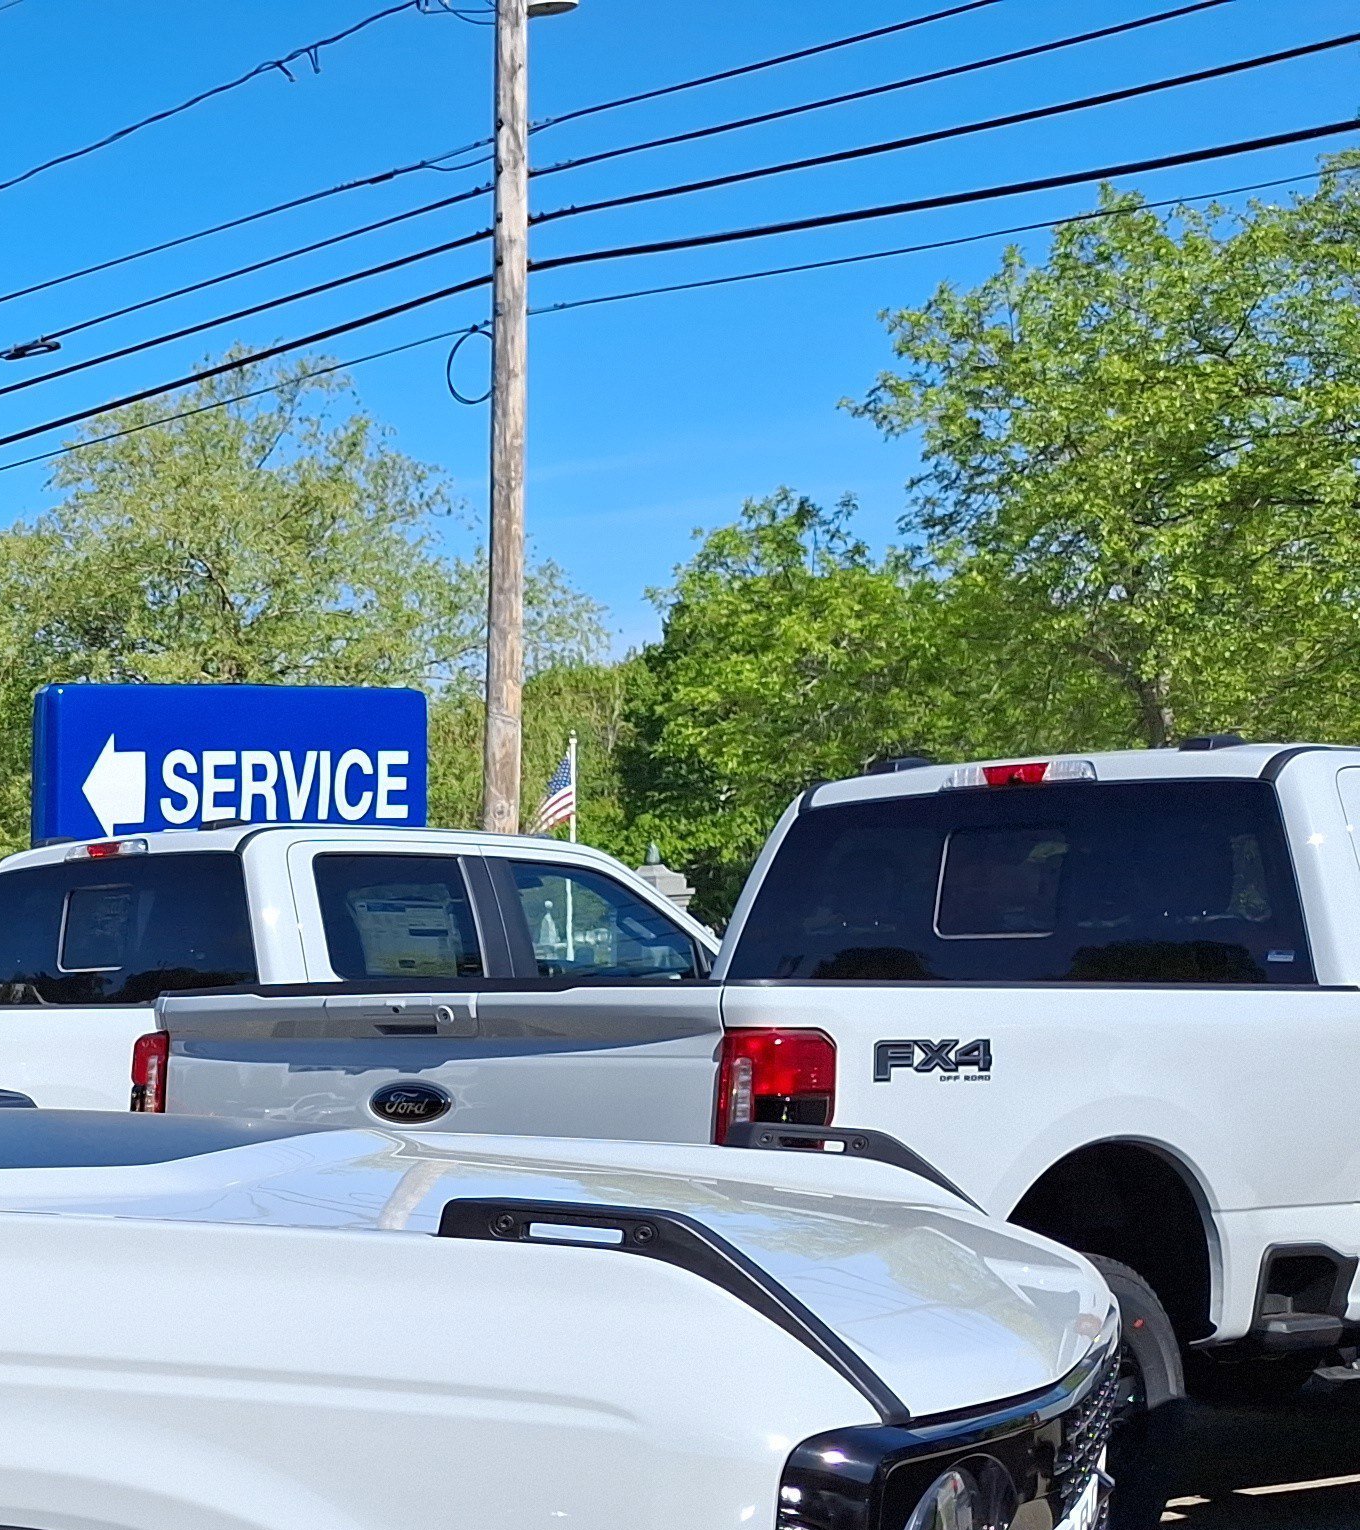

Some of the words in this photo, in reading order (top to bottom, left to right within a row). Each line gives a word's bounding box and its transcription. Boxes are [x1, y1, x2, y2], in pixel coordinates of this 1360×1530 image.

[159, 748, 410, 824] SERVICE
[873, 1038, 992, 1082] FX4
[939, 1074, 961, 1083] OFF
[963, 1074, 991, 1082] ROAD
[385, 1091, 429, 1114] Ford
